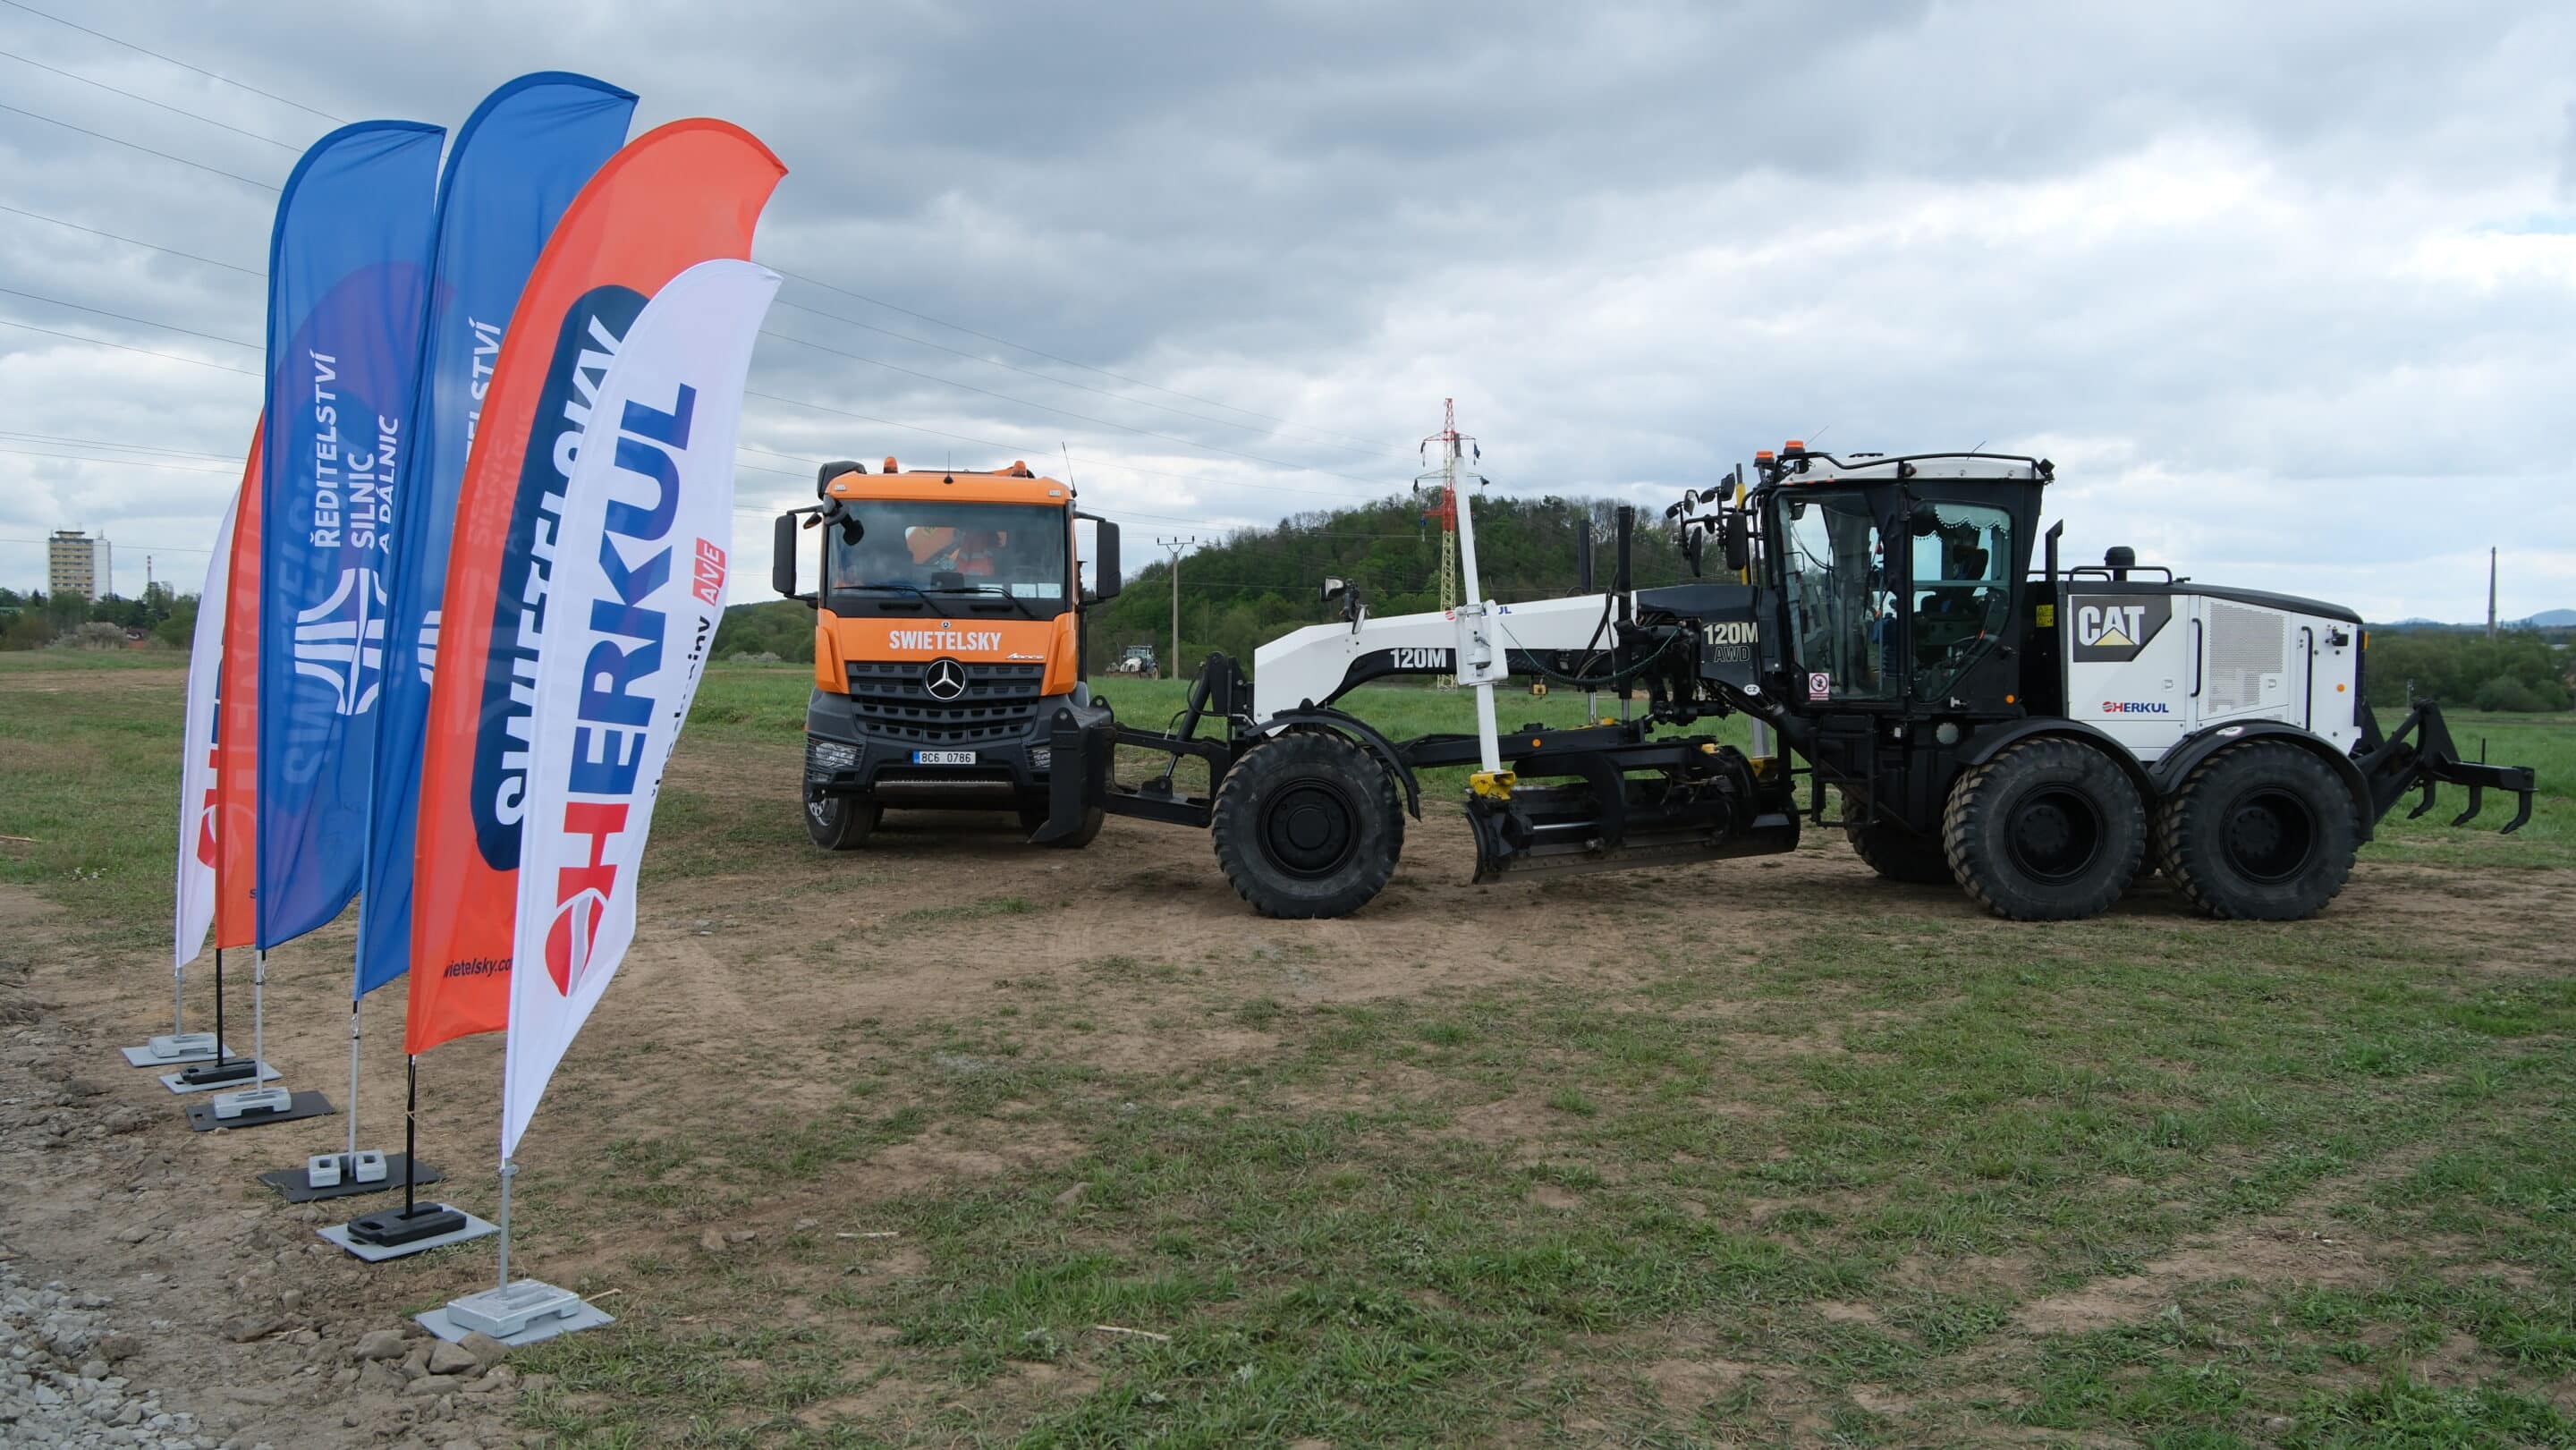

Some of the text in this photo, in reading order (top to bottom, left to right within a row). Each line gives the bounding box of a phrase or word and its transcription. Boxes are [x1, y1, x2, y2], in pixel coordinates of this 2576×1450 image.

[309, 349, 341, 547] ŘEDITELSTVÍ
[376, 415, 399, 555] A DÁLNIC
[347, 452, 376, 550] SILNIC
[698, 540, 722, 606] AVE
[889, 631, 1001, 651] SWIETELSKY
[1704, 623, 1758, 644] 120M
[2079, 606, 2145, 646] CAT
[556, 383, 697, 909] HERKUL
[1390, 648, 1446, 668] 120M
[1714, 646, 1750, 663] AWD
[2113, 702, 2169, 713] HERKUL
[921, 752, 971, 763] 8C6 0786
